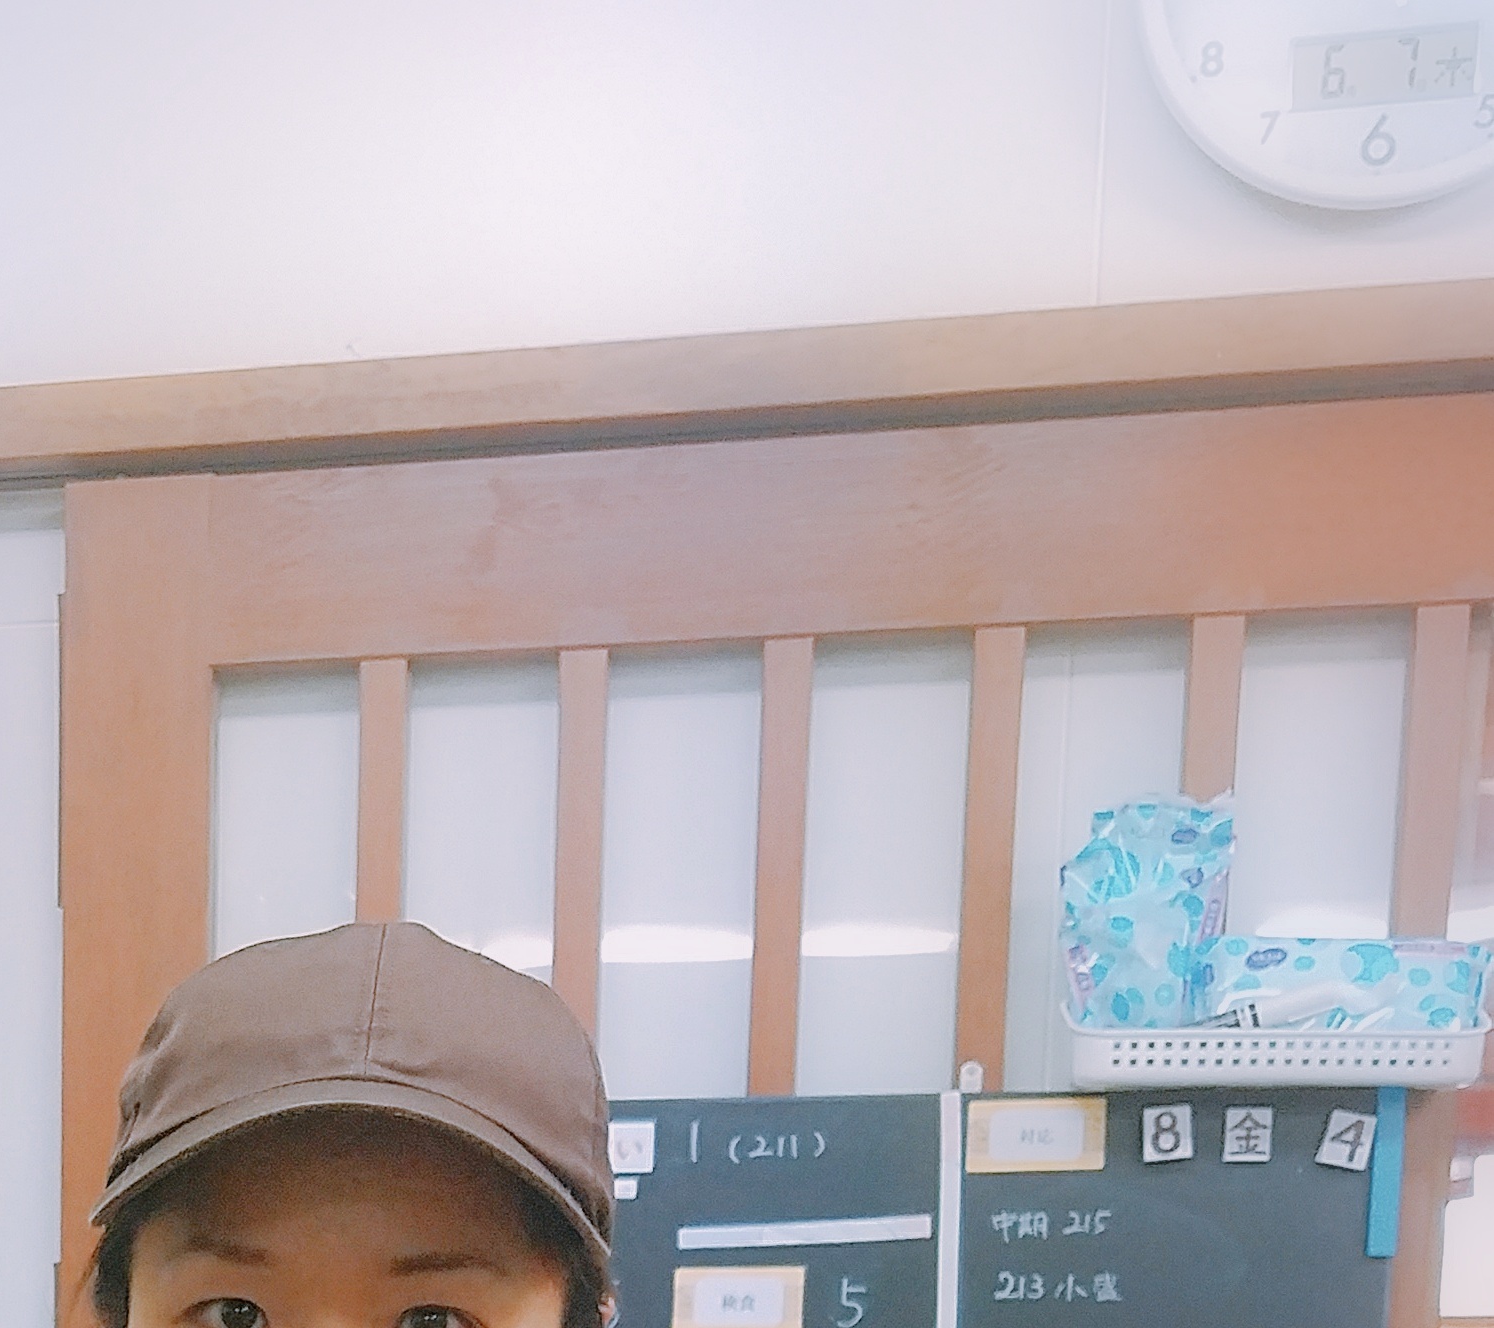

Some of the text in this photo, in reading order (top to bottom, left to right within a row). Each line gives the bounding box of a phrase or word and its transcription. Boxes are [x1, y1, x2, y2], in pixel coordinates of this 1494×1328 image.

[1200, 40, 1224, 77] 8
[1260, 110, 1280, 145] 7
[1361, 113, 1396, 166] 6
[1150, 1111, 1366, 1163] 8 金 4
[1061, 1208, 1113, 1236] 215
[836, 1277, 868, 1328] 5
[994, 1270, 1046, 1301] 213
